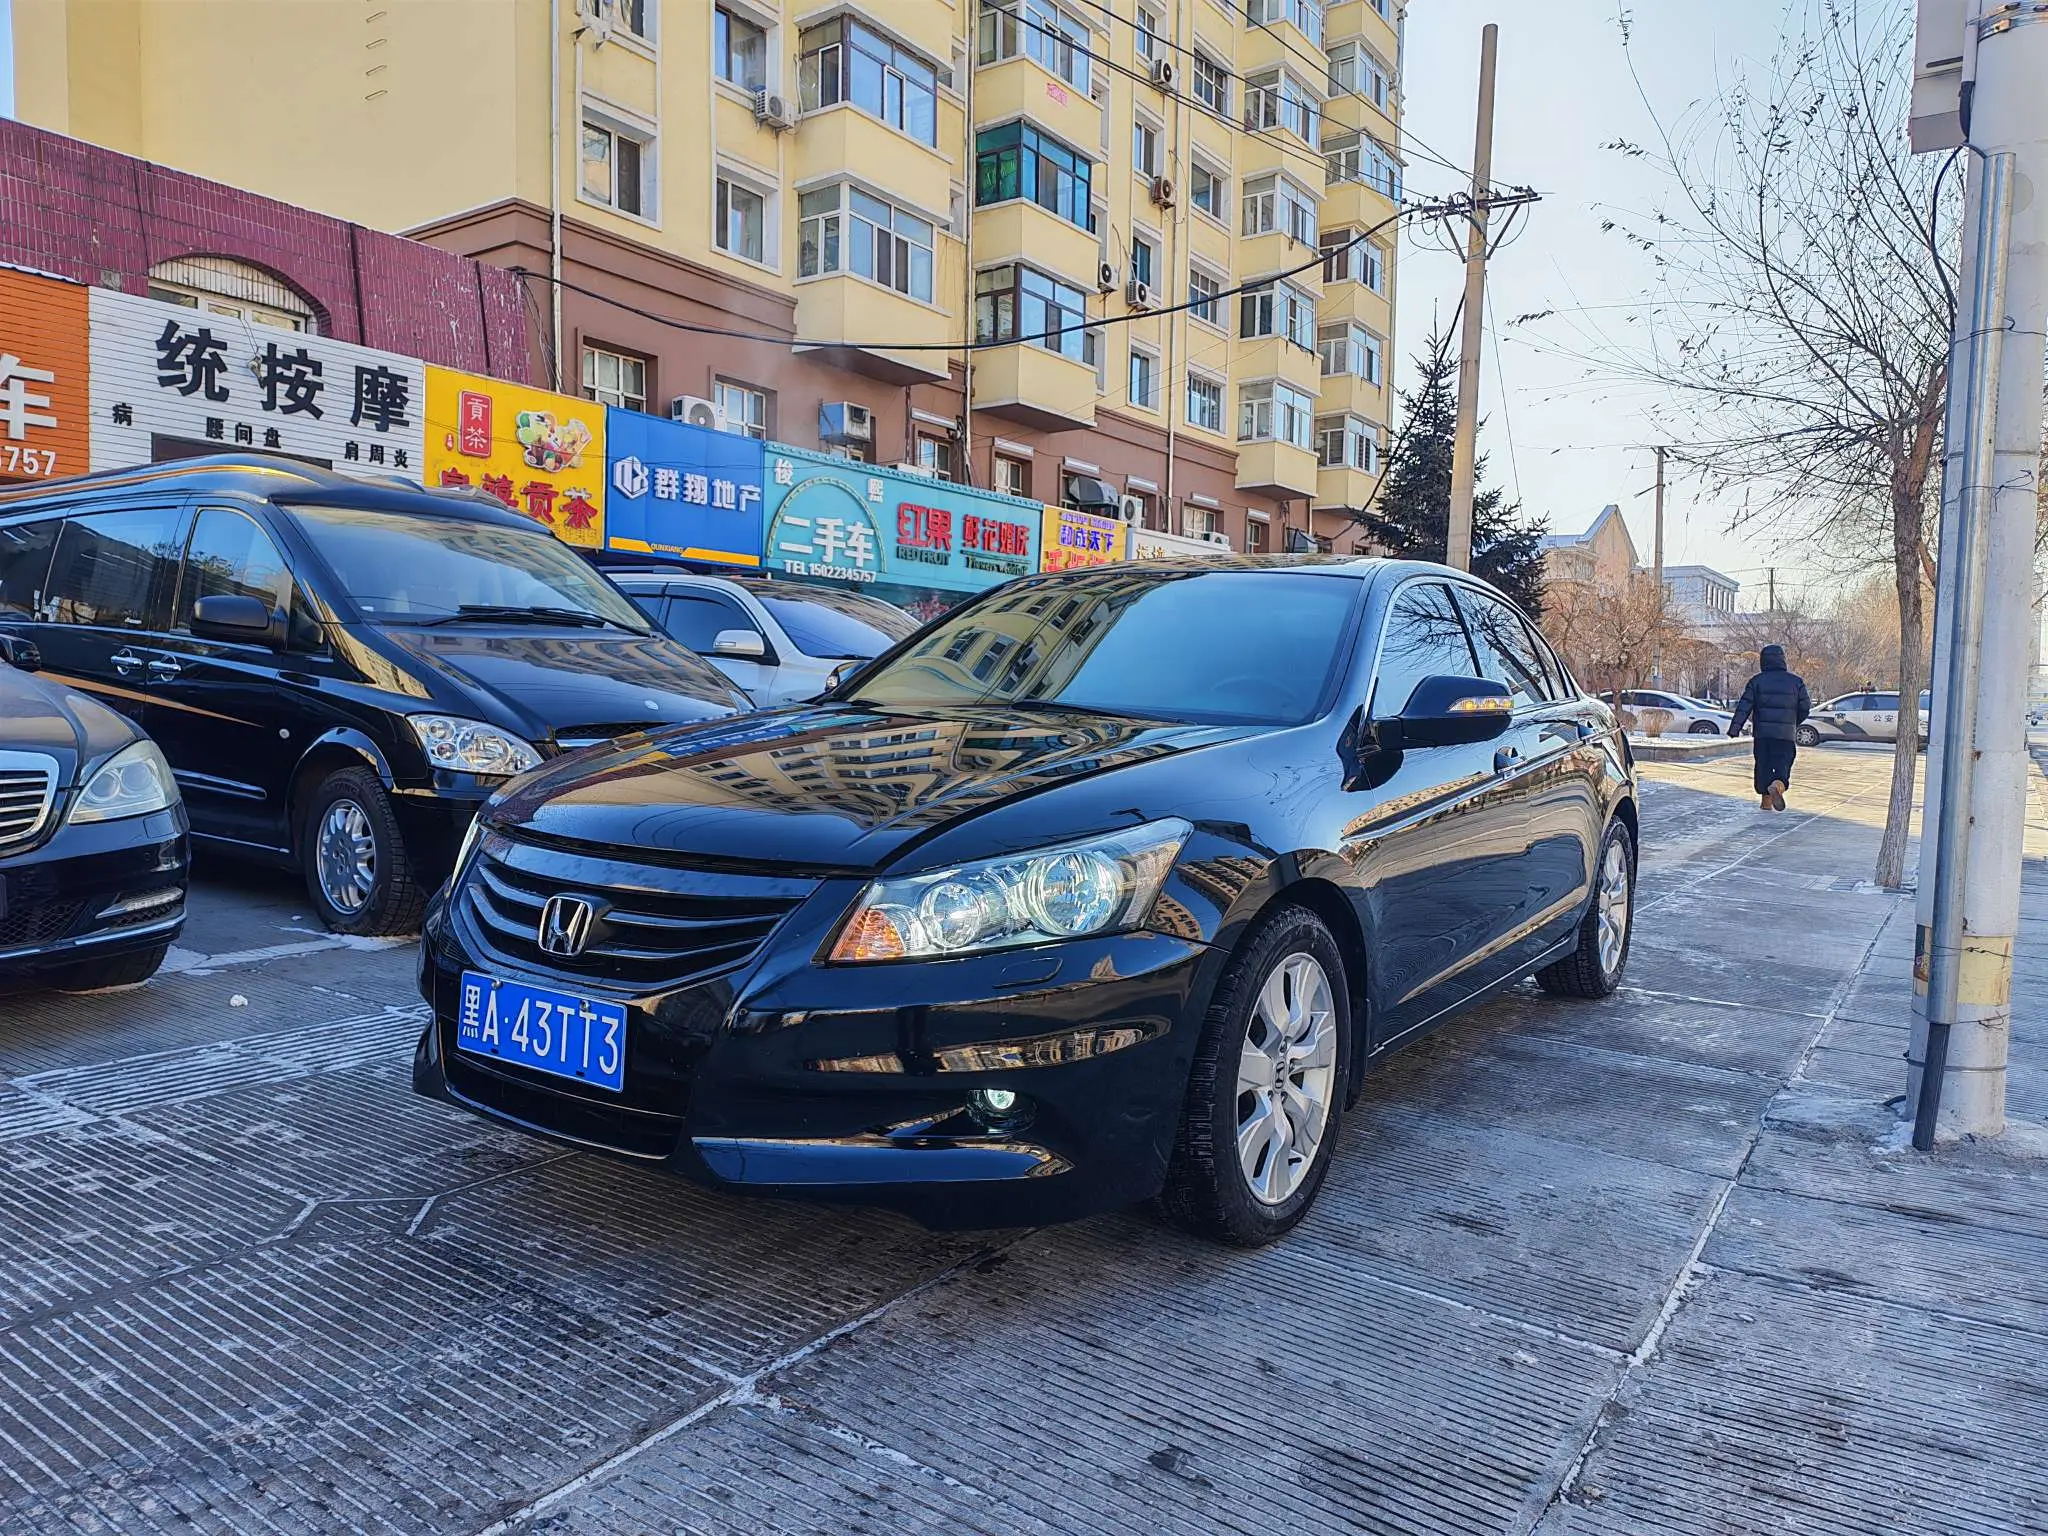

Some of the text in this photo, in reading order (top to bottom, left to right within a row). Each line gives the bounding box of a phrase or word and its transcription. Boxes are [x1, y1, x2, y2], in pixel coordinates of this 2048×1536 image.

[155, 319, 411, 433] 统按摩
[0, 445, 56, 476] 757
[112, 402, 409, 469] 病 腰间盘 肩周炎
[654, 467, 761, 513] 群翔地产
[779, 515, 875, 568] 二手车
[897, 502, 952, 552] 红果
[784, 560, 808, 575] TEL
